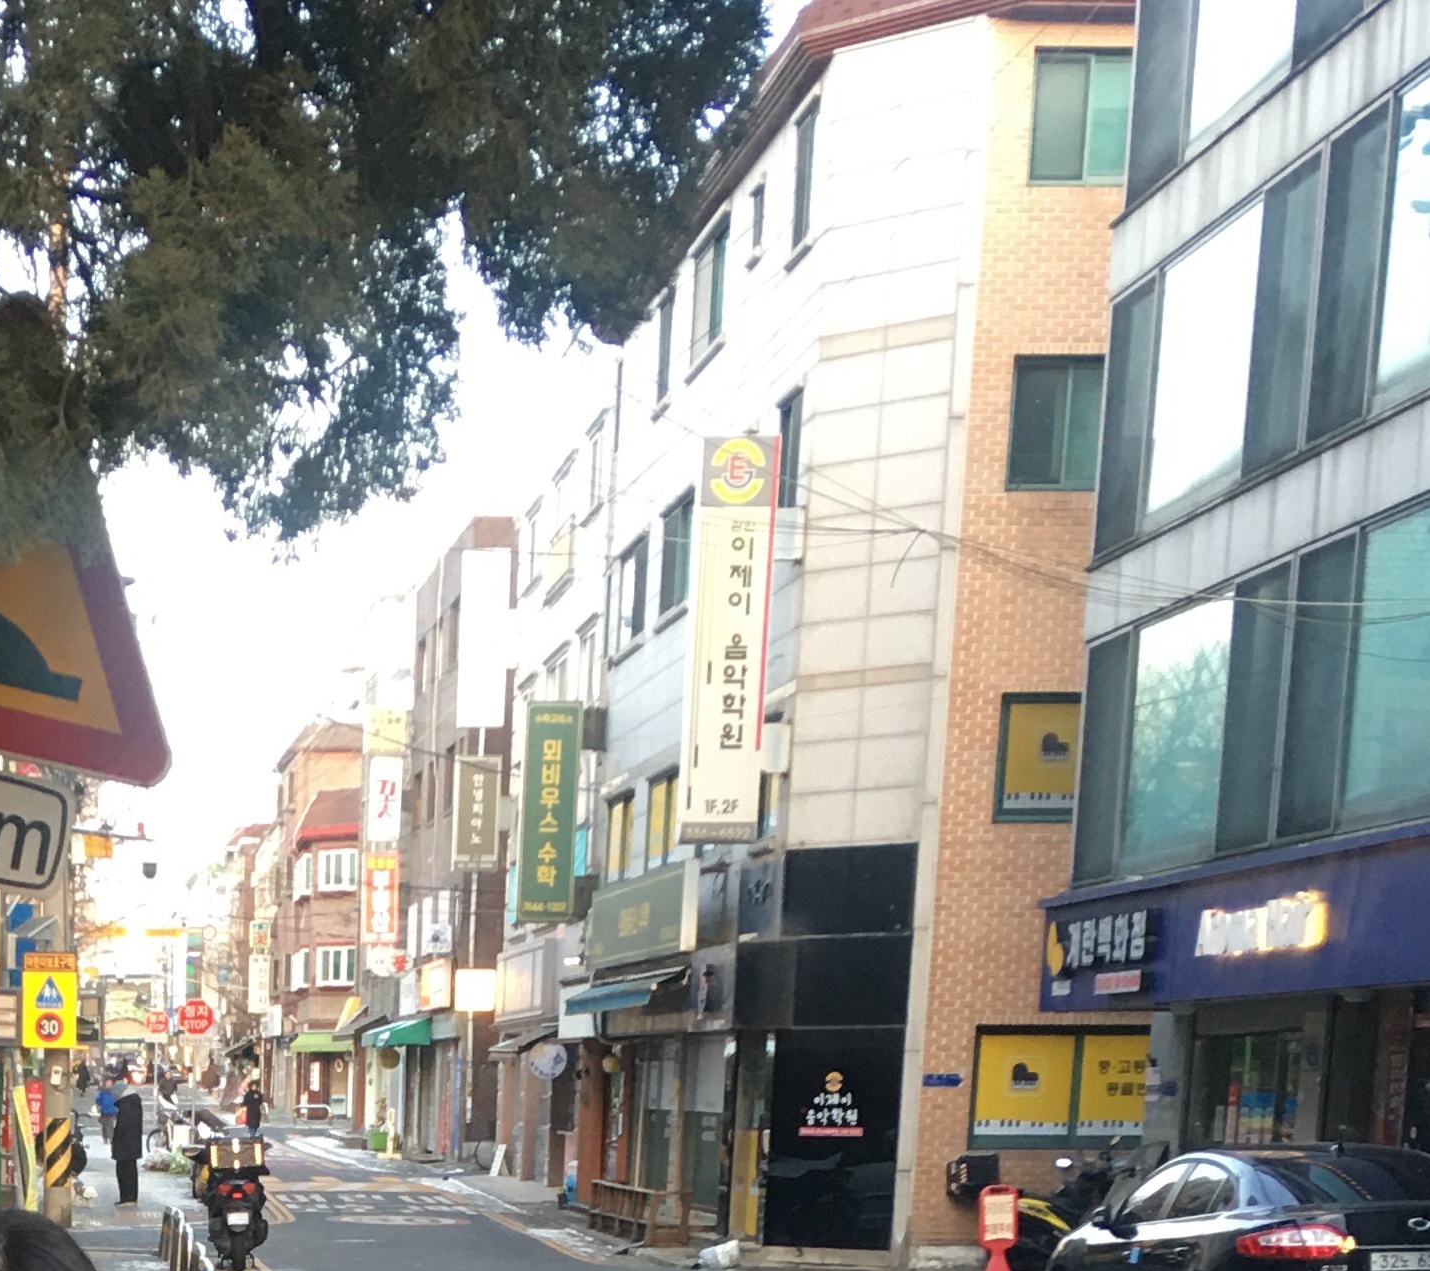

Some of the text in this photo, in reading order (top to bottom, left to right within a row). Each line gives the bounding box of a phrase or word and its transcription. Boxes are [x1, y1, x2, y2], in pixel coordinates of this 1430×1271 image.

[728, 536, 754, 616] 이제이
[720, 633, 748, 750] 음악학원
[536, 739, 562, 888] 뫼비우스 수학
[705, 799, 739, 816] 1F,2F
[1066, 909, 1147, 970] 계란백화점
[185, 1005, 208, 1018] 정지
[40, 1019, 59, 1035] 30
[184, 1019, 208, 1030] STOP
[806, 1108, 858, 1126] 음악학원
